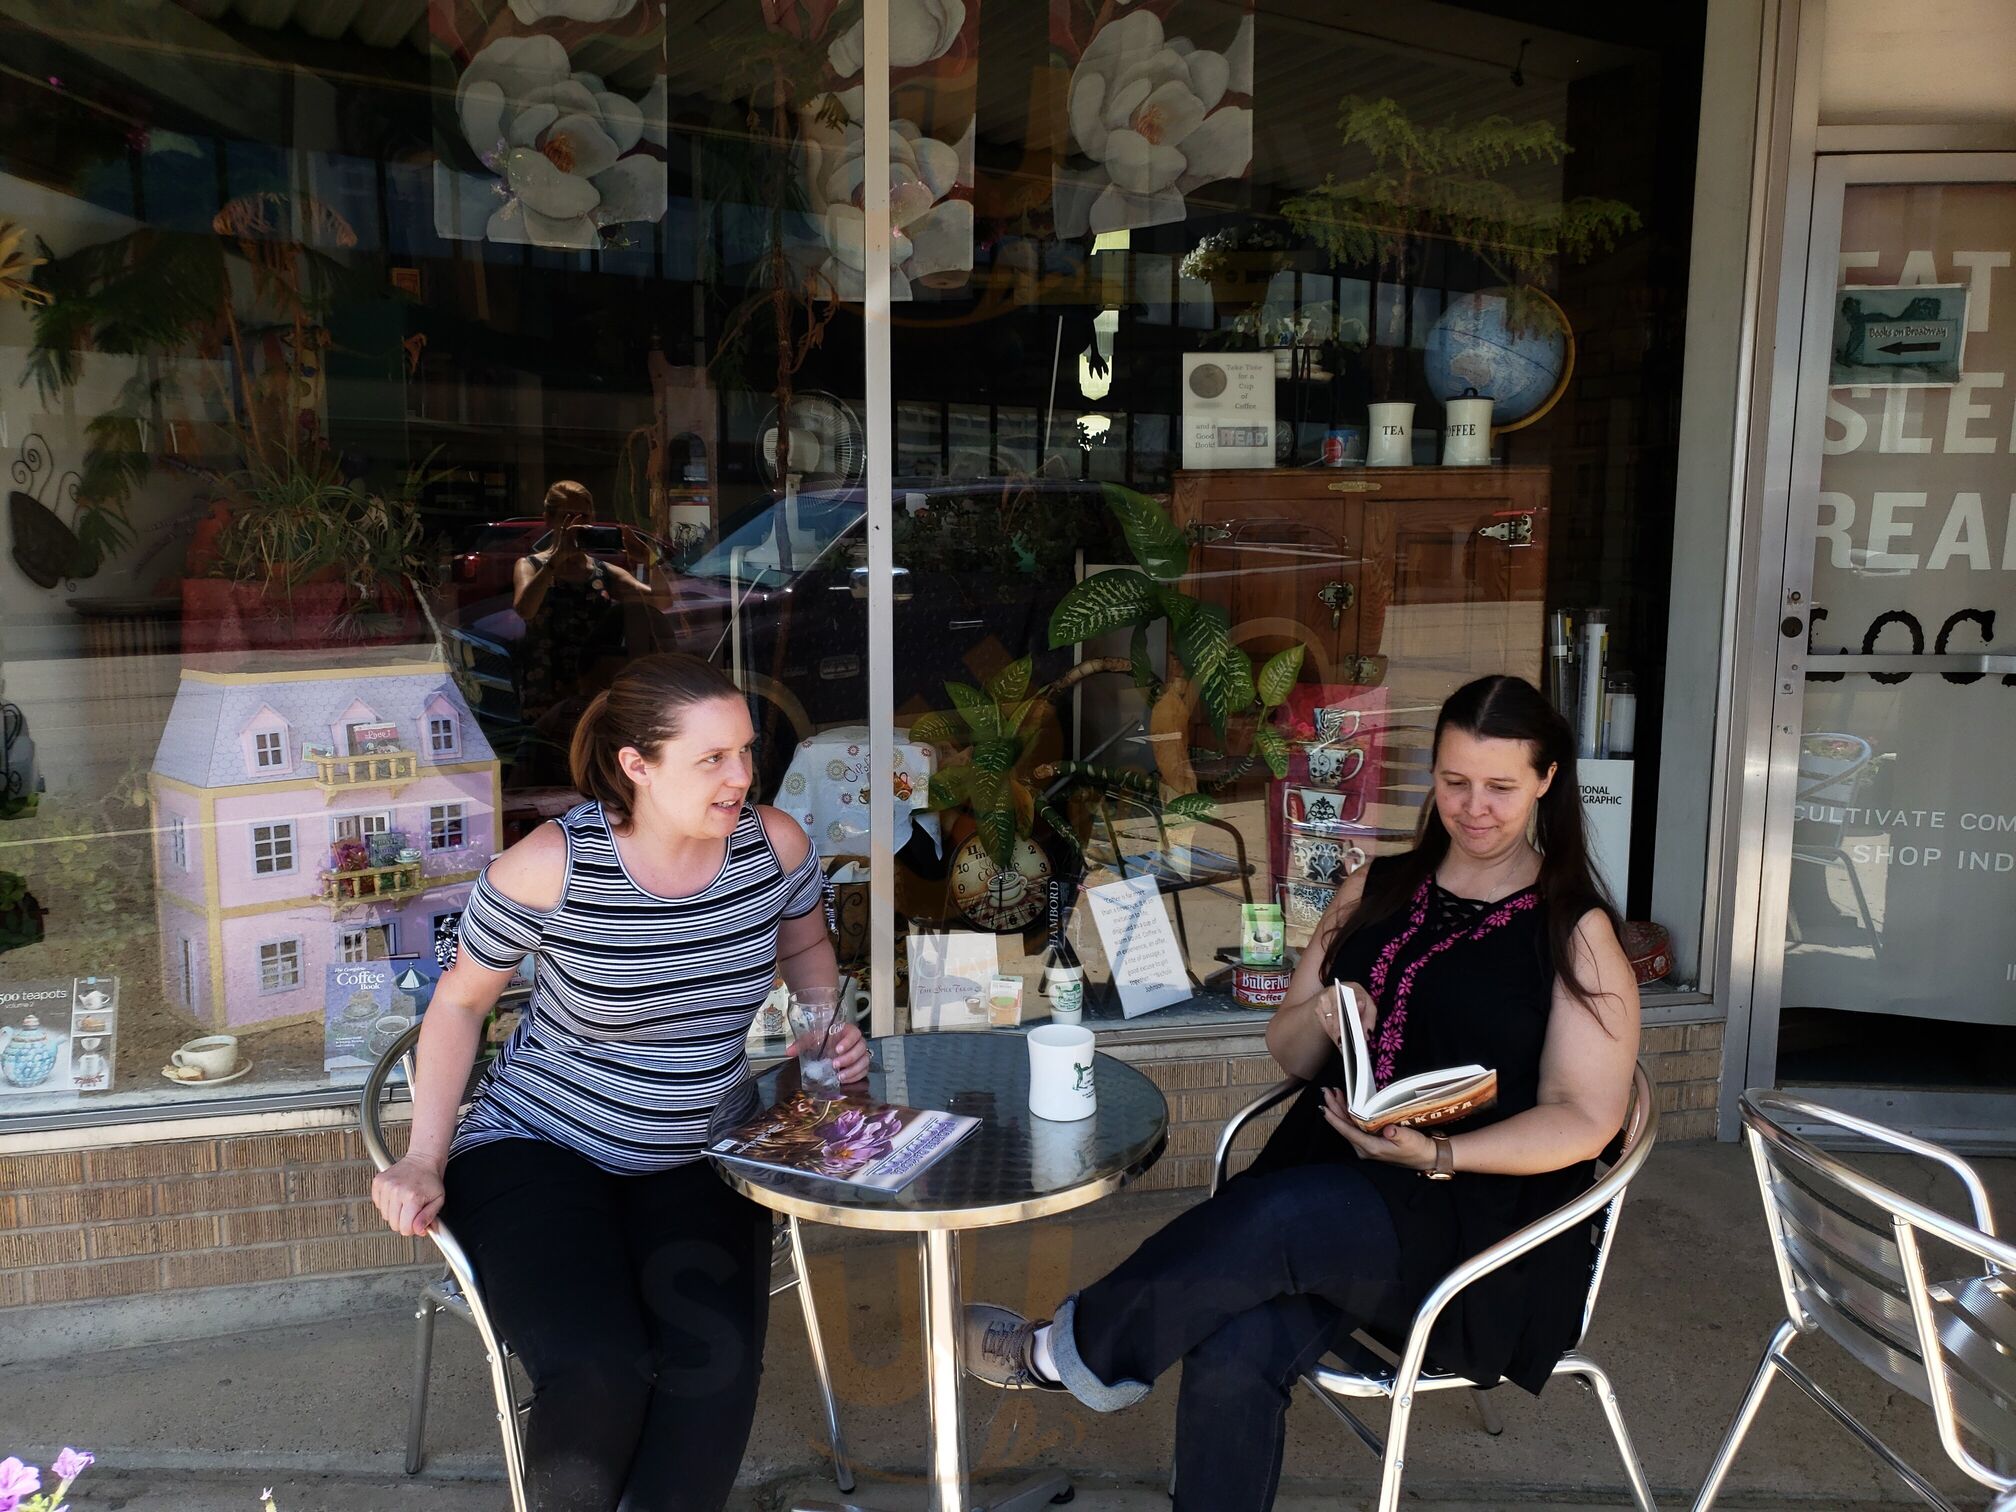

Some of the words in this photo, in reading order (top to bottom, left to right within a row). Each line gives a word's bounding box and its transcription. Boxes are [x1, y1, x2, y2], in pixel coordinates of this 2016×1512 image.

[1869, 327, 1892, 337] Books
[1904, 327, 1947, 338] Broadway
[1822, 372, 2016, 455] SLE
[1383, 425, 1404, 436] TEA
[1816, 492, 2016, 570] REA
[1795, 804, 1946, 829] CULTIVATE
[1028, 845, 1036, 854] 2
[1852, 844, 1942, 867] SHOP
[1040, 863, 1047, 873] 3
[958, 884, 966, 894] 9
[336, 971, 385, 986] Coffee
[22, 989, 67, 1001] teapots
[1255, 993, 1282, 1002] Coffee
